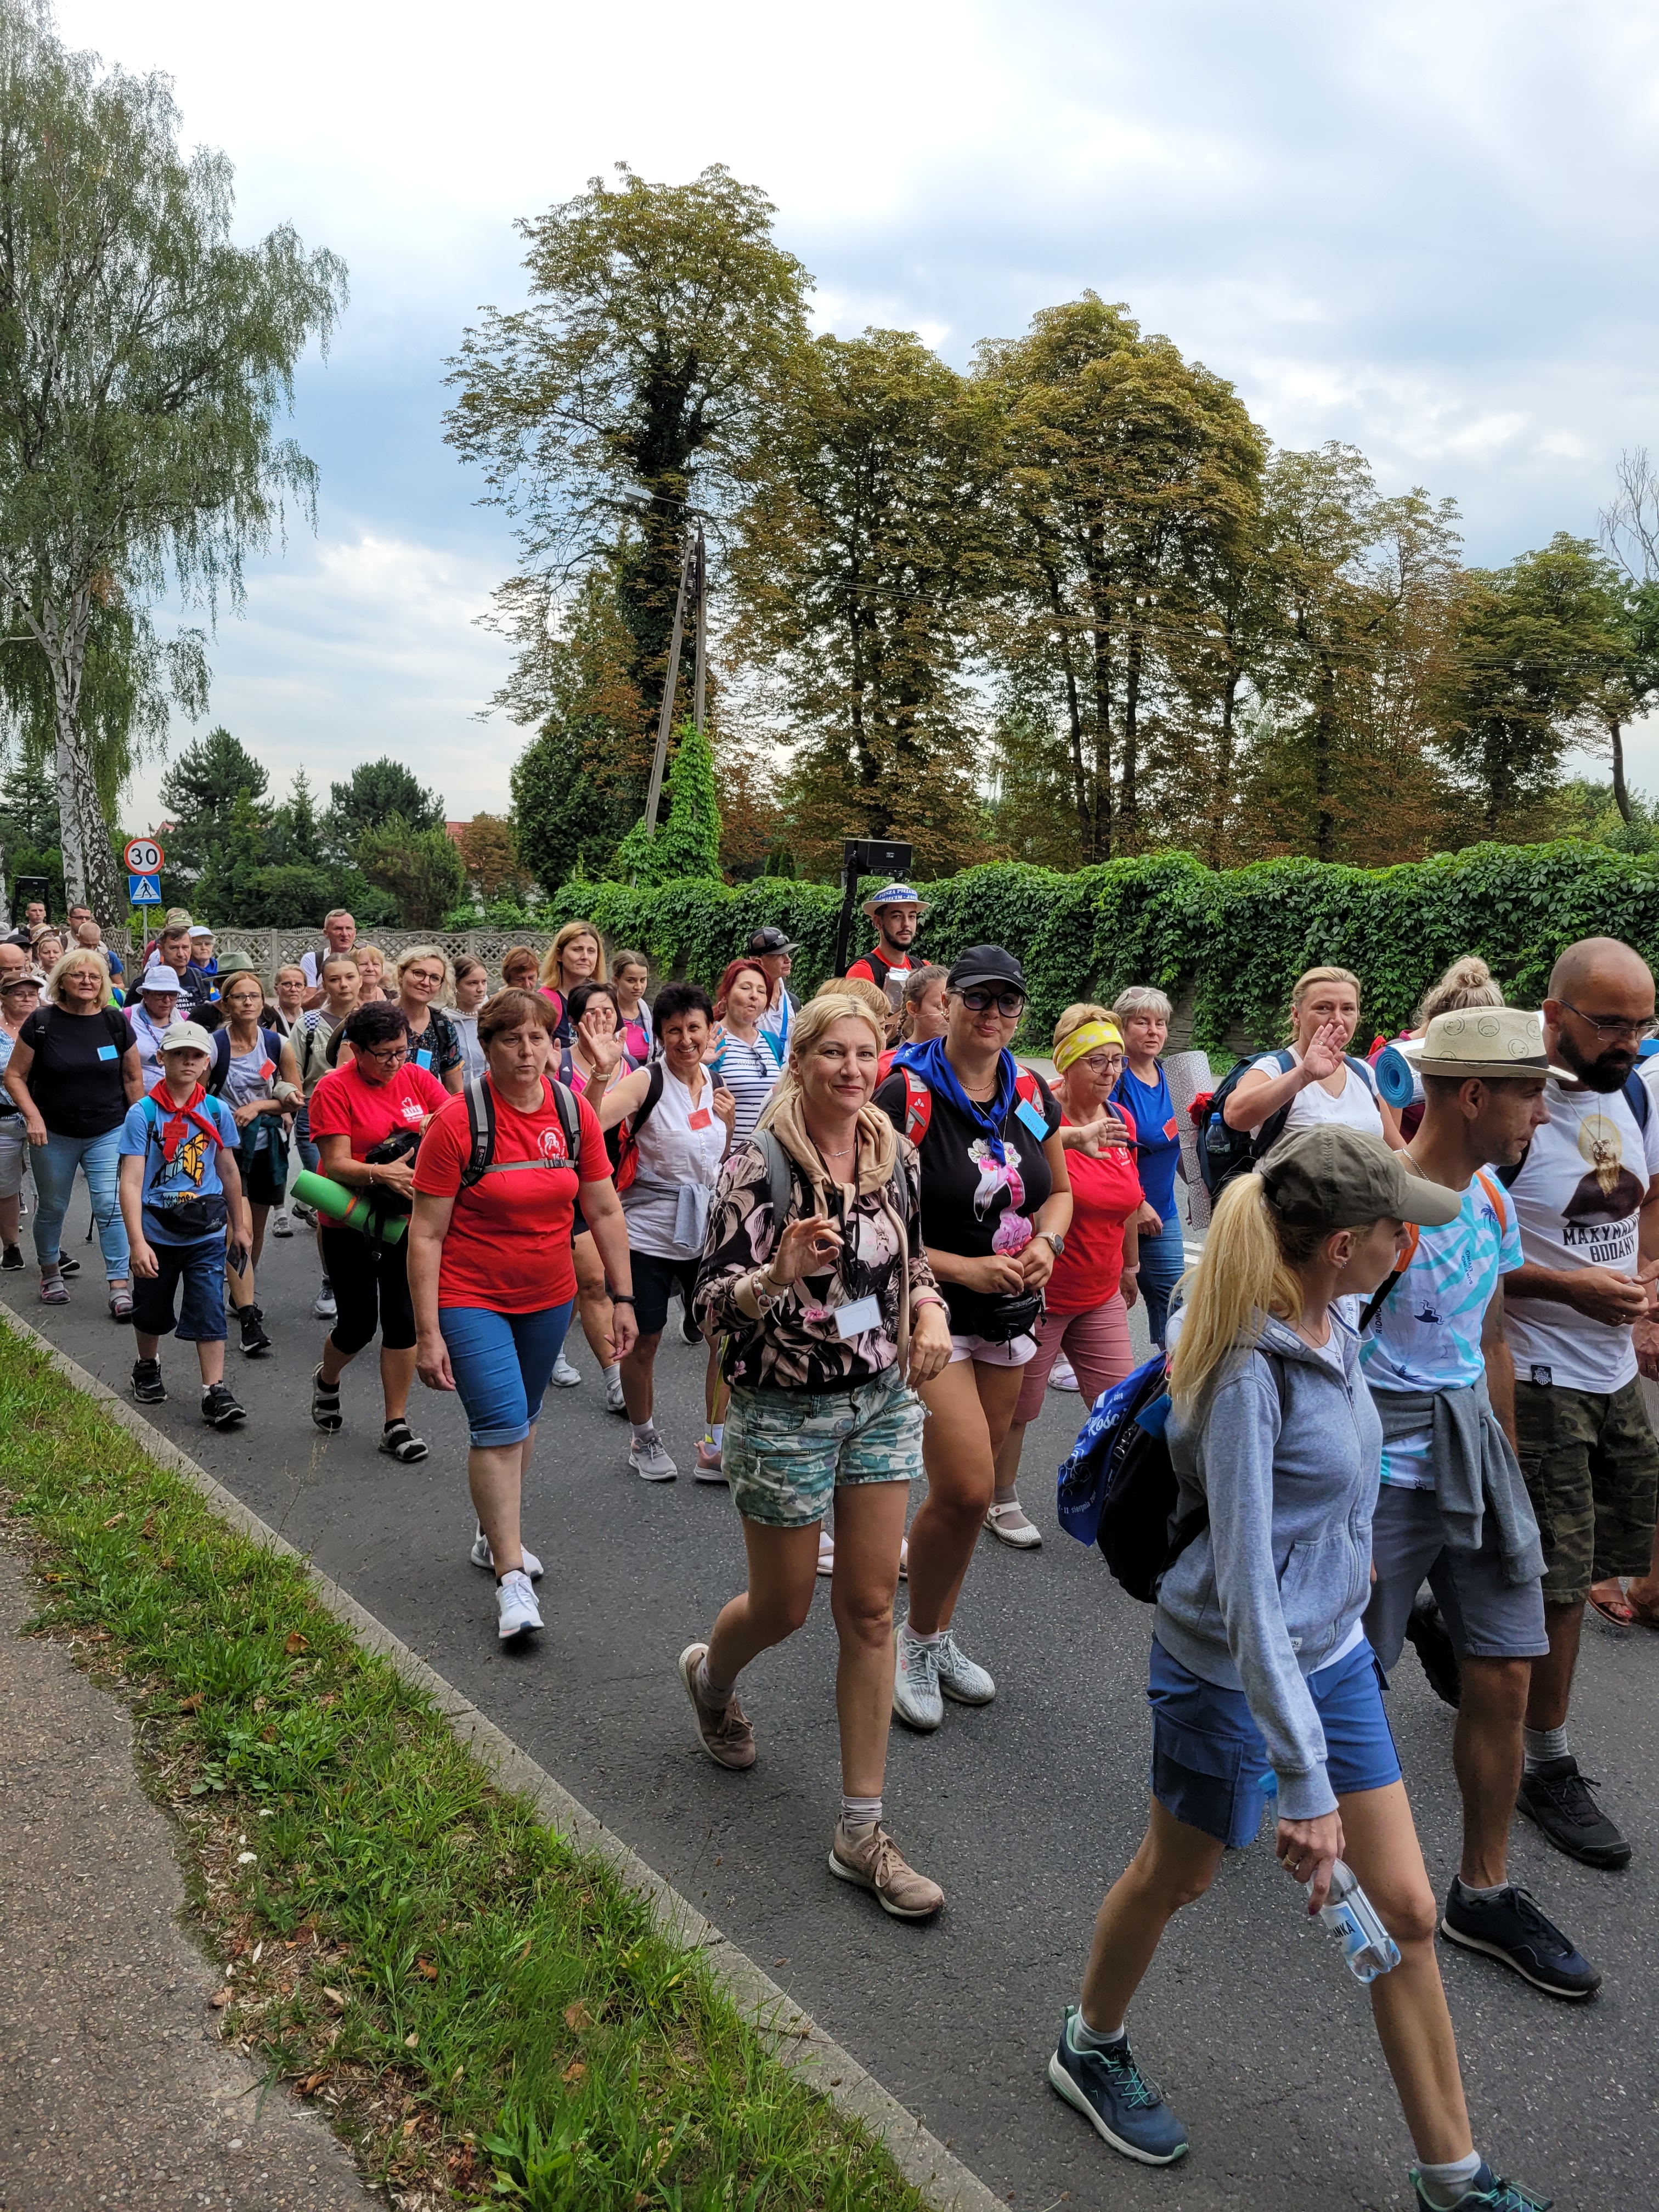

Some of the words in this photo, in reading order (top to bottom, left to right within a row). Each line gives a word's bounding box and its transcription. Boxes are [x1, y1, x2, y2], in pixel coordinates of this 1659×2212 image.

[131, 848, 158, 865] 30
[1461, 1255, 1473, 1284] SURFING
[1071, 1501, 1091, 1514] sierpnia
